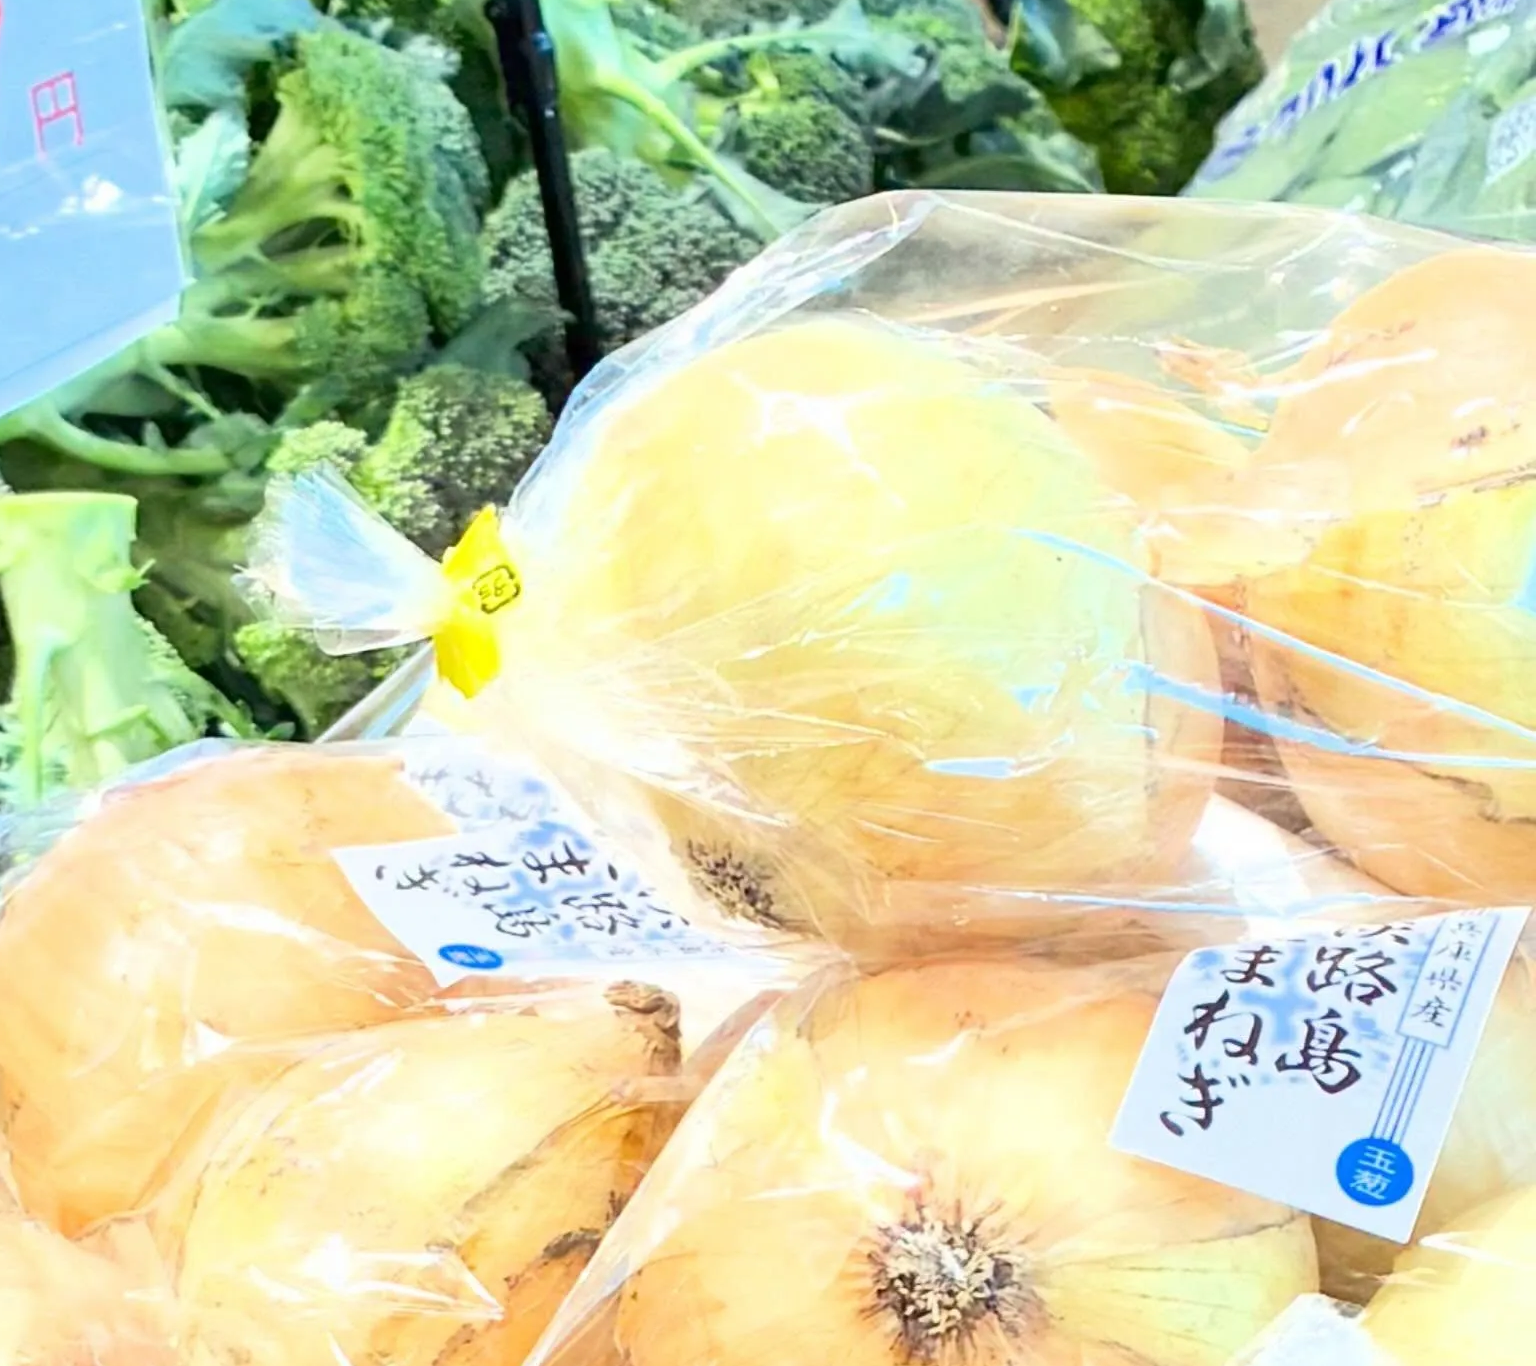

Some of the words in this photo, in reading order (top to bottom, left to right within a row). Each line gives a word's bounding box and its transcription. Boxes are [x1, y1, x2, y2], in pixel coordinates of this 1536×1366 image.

[375, 840, 619, 898] まねぎ
[1159, 939, 1282, 1137] まねぎ
